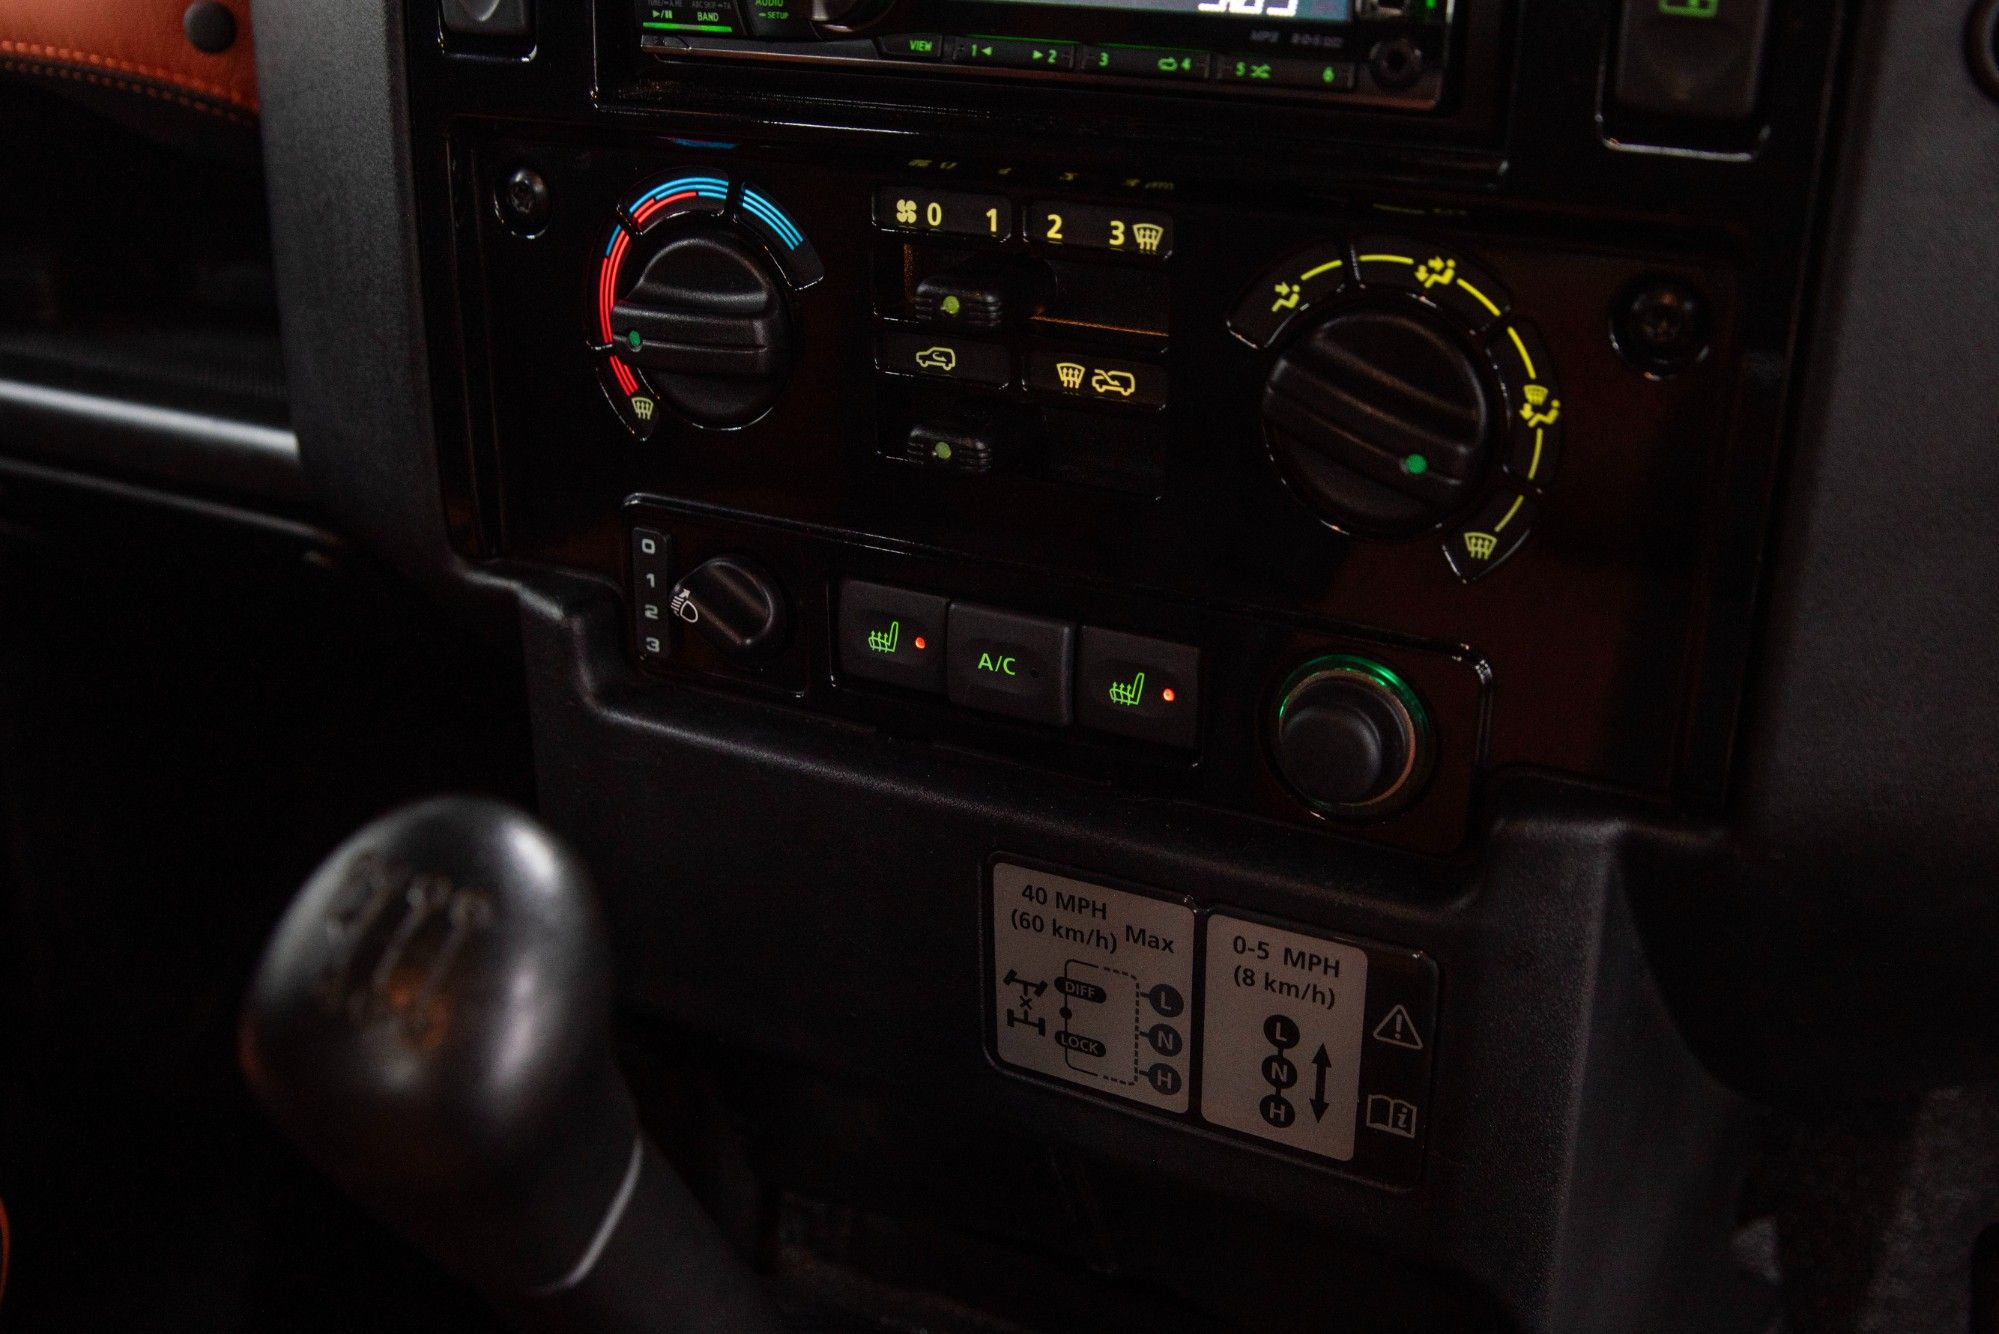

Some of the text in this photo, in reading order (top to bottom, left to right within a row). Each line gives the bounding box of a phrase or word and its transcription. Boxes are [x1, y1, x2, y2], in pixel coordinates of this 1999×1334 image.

[697, 11, 719, 22] BAND
[767, 11, 789, 20] SETUP
[909, 40, 933, 51] VIEW
[971, 44, 978, 57] 1
[1047, 49, 1057, 64] 2
[1099, 52, 1109, 67] 3
[1181, 57, 1192, 71] 4
[1235, 61, 1246, 77] 5
[1322, 66, 1335, 83] 6
[926, 201, 998, 233] 0 1
[1046, 213, 1126, 246] 2 3
[641, 538, 656, 555] 0
[646, 572, 656, 588] 1
[644, 605, 659, 620] 2
[645, 637, 660, 653] 3
[977, 652, 1016, 676] A/C
[1021, 884, 1108, 921] 40 MPH
[1011, 909, 1175, 954] (60 km/h) Max
[1232, 935, 1341, 978] 0-5 MPH
[1064, 980, 1098, 999] DIFF
[1233, 965, 1337, 1010] (8 km/h)
[1159, 990, 1172, 1010] L
[1156, 1030, 1174, 1052] N
[1275, 1022, 1287, 1043] L
[1060, 1034, 1100, 1057] LOCK
[1156, 1069, 1174, 1090] H
[1271, 1061, 1288, 1082] N
[1268, 1100, 1287, 1123] H
